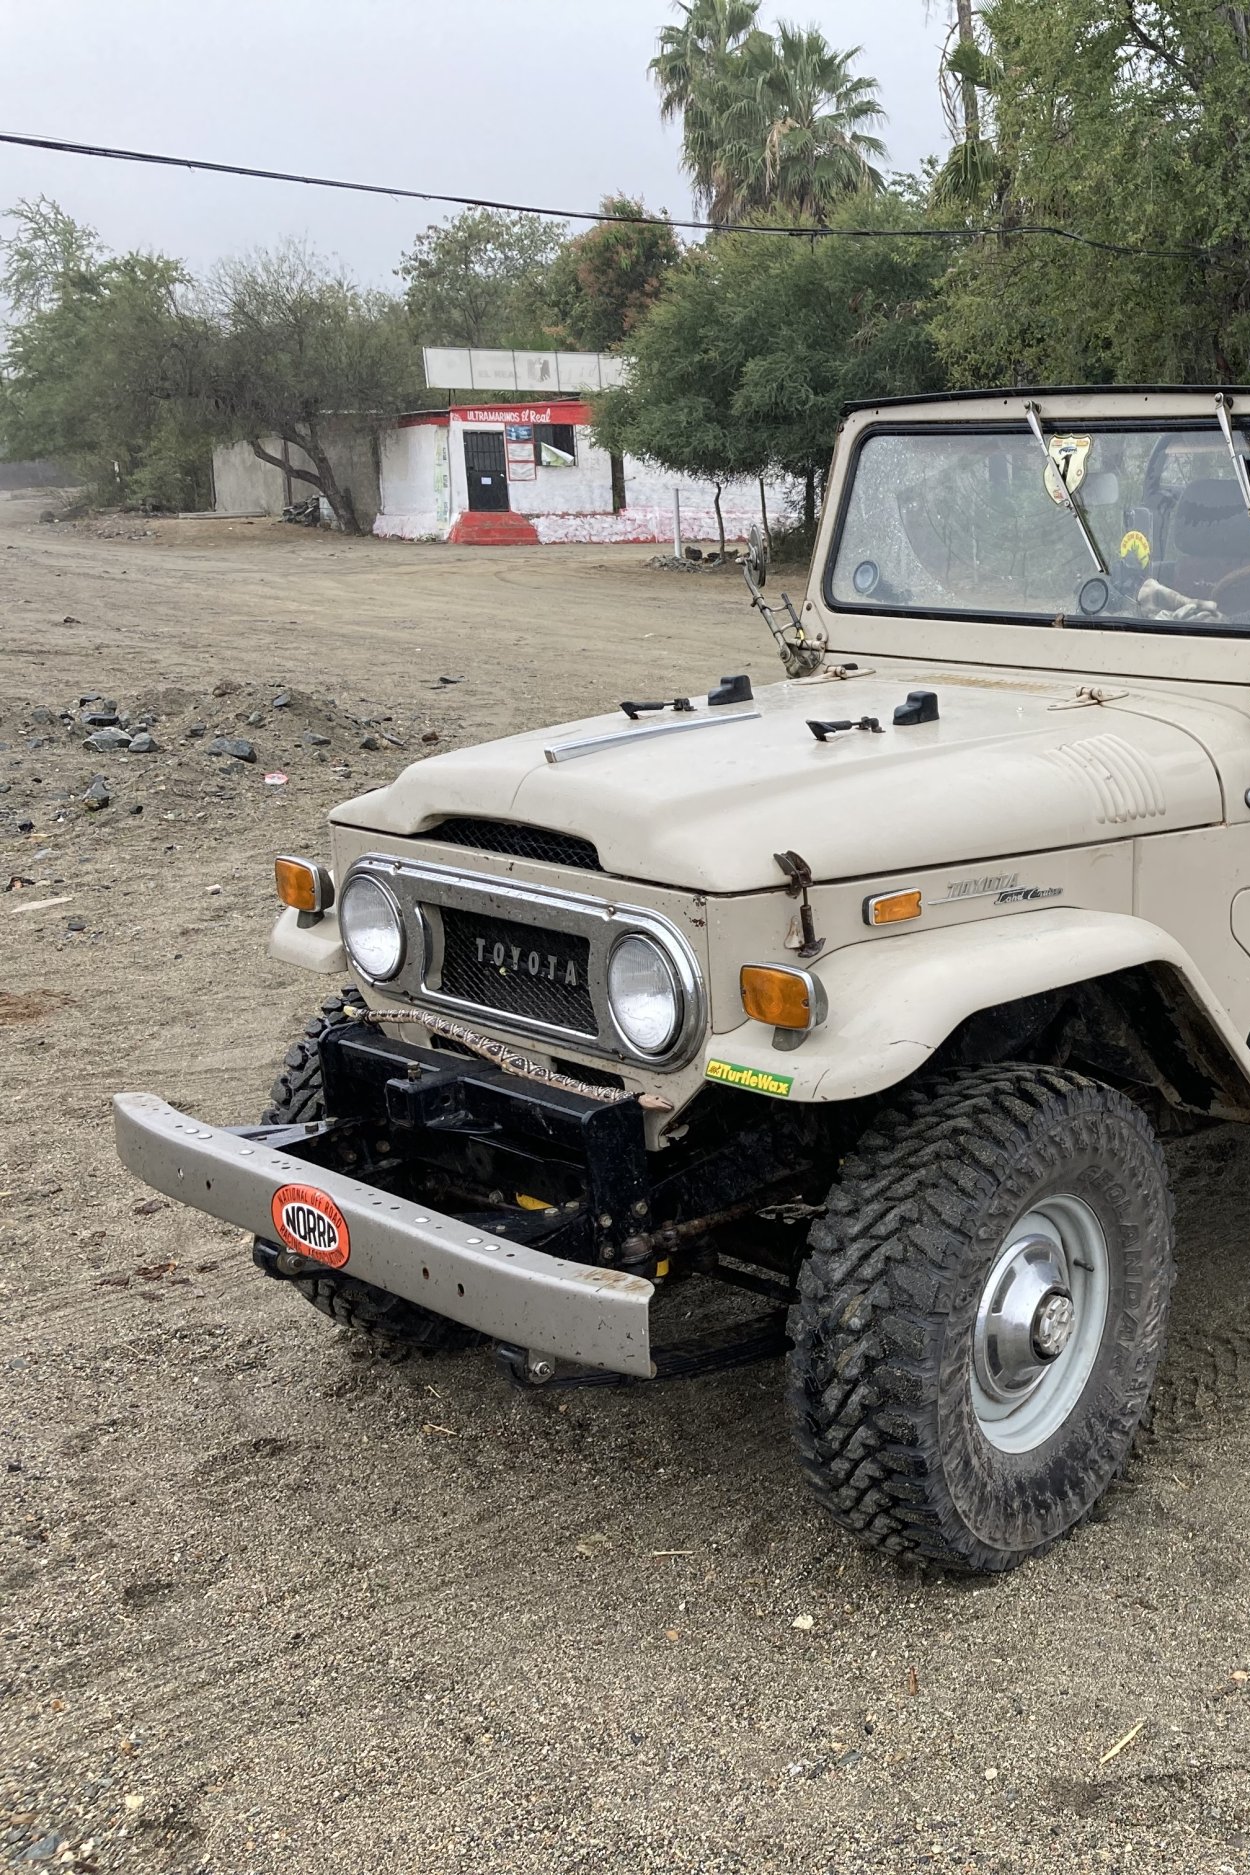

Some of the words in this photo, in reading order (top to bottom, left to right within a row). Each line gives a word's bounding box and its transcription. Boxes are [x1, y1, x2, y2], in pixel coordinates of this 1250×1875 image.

[467, 410, 519, 422] ULTRAMARINOS
[530, 408, 551, 423] Real
[947, 873, 1018, 898] TOYOTA
[476, 938, 577, 986] TOYOTA
[719, 1063, 790, 1095] TurtleWax
[278, 1188, 308, 1204] NATIONAL
[310, 1192, 324, 1209] OFF
[324, 1201, 342, 1229] ROAD
[285, 1205, 338, 1249] NORRA
